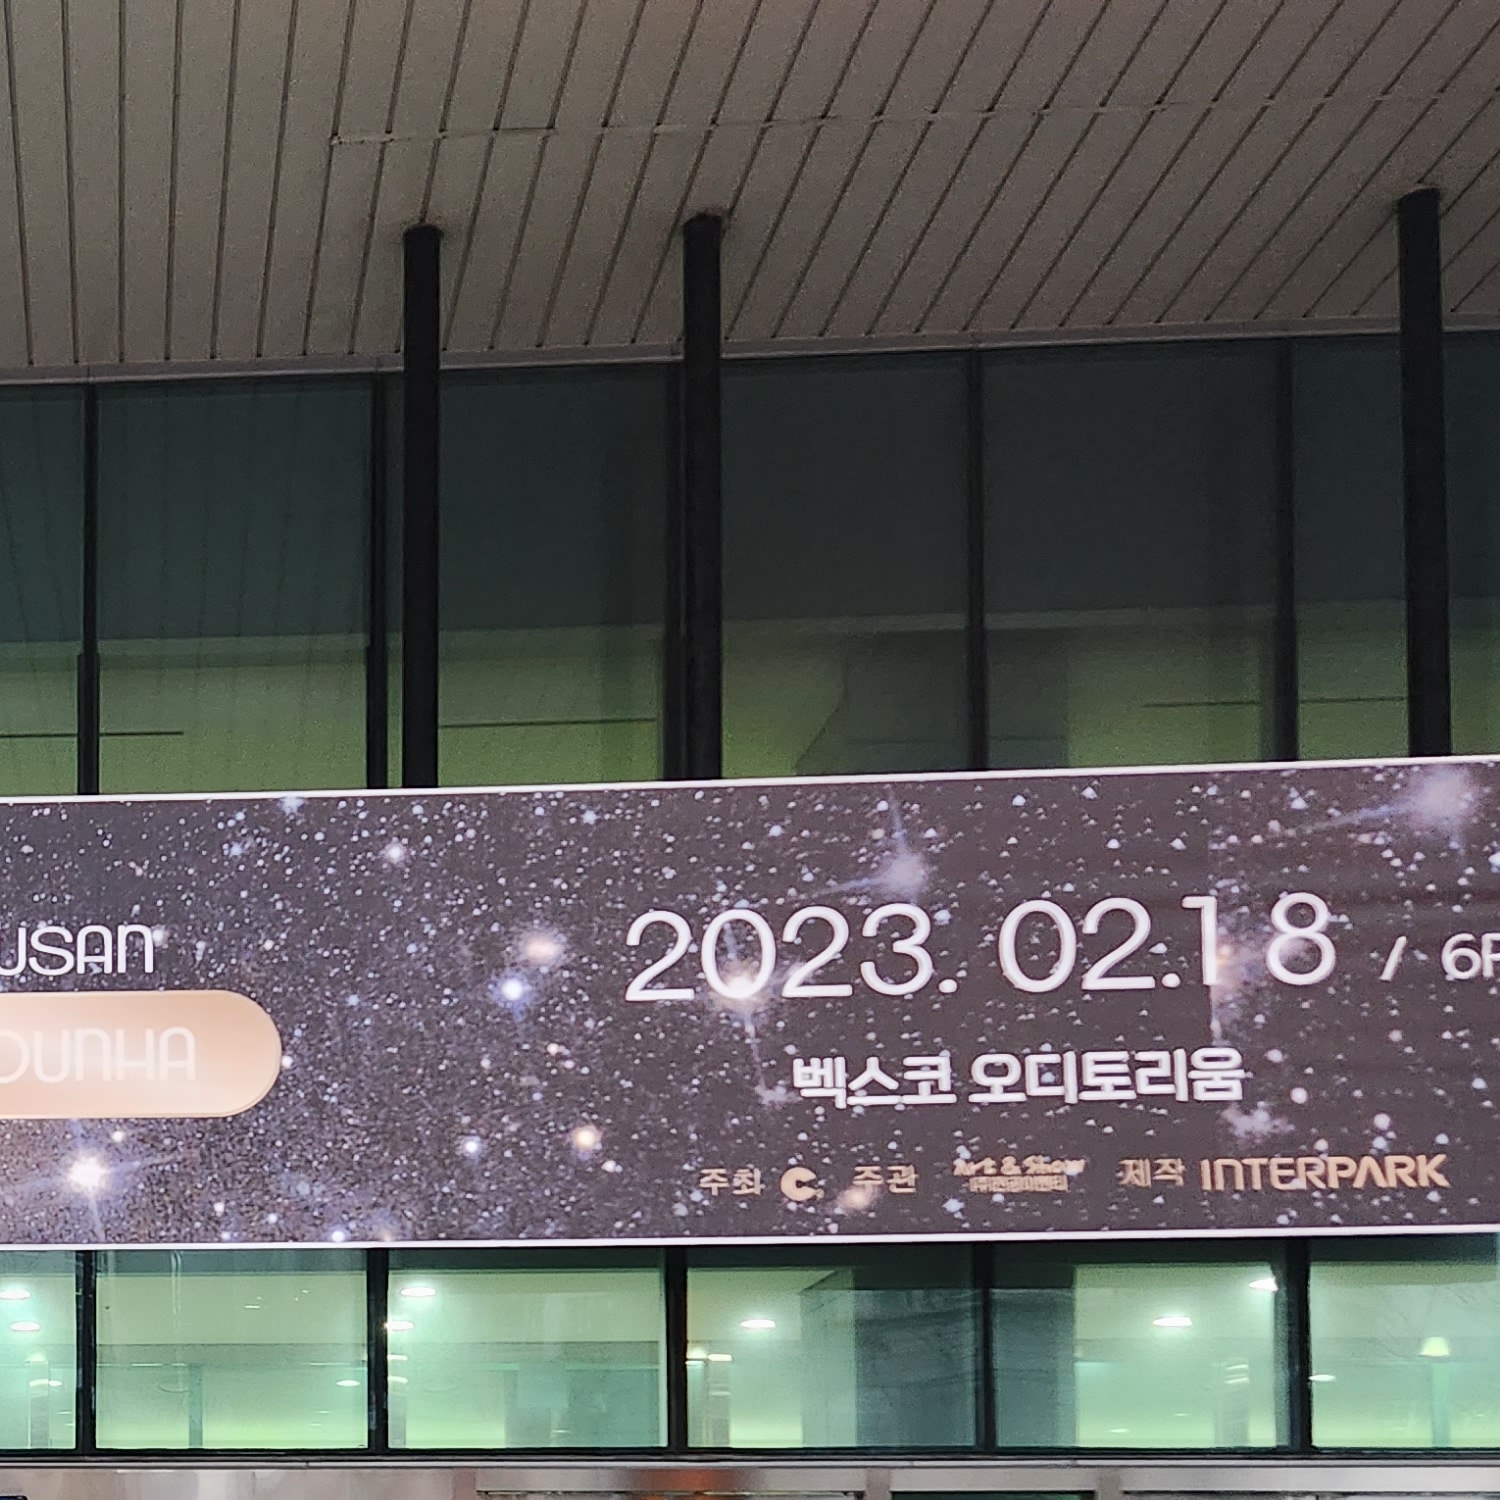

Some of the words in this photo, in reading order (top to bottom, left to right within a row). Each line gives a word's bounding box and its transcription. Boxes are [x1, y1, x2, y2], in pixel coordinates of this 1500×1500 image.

[625, 903, 958, 1001] 2023.
[792, 1055, 958, 1110] 벡스코
[968, 1046, 1246, 1104] 오디토리움
[699, 1167, 762, 1196] 주최
[852, 1164, 918, 1195] 주관
[1115, 1157, 1186, 1188] 제작
